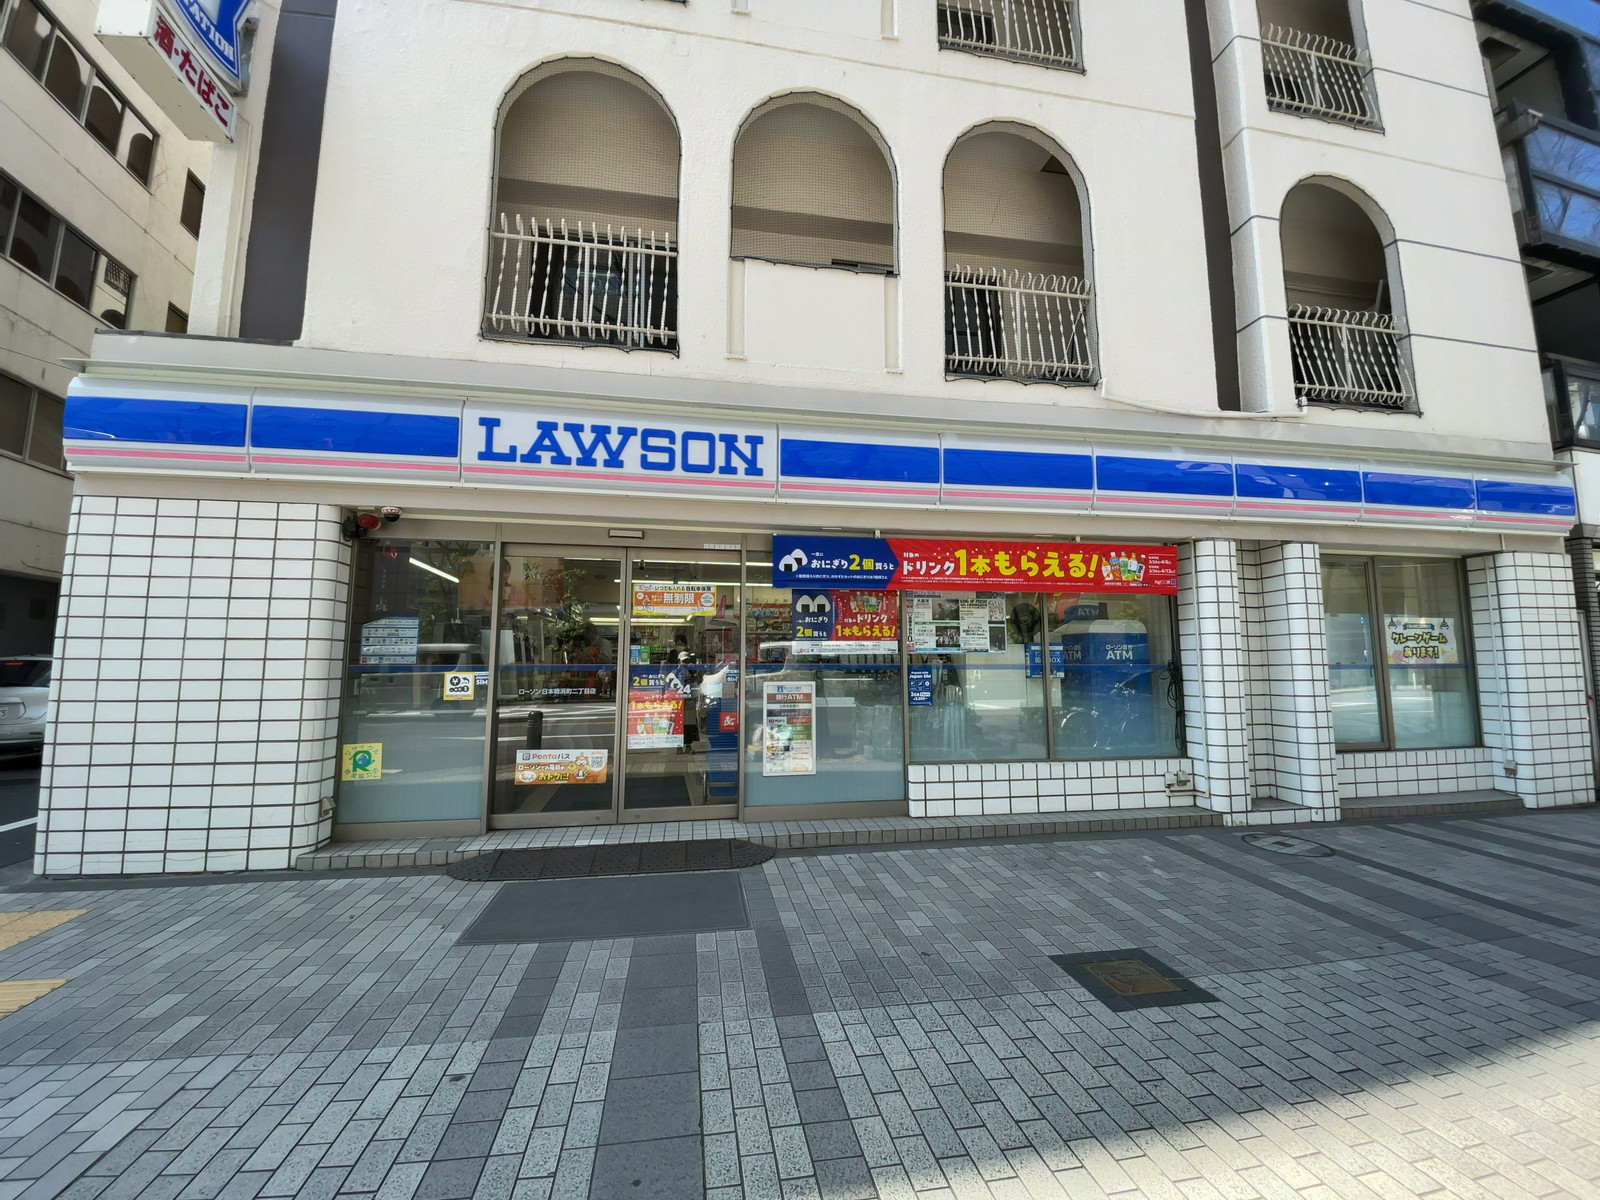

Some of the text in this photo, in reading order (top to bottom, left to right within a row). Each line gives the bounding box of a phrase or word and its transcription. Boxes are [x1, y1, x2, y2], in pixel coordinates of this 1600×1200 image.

[477, 416, 764, 476] LAWSON
[663, 593, 695, 604] 無制限
[835, 624, 896, 638] 1本もらえる!
[1391, 632, 1448, 645] クレーンゲーム
[1106, 651, 1133, 660] ATM
[1403, 645, 1440, 659] あります!
